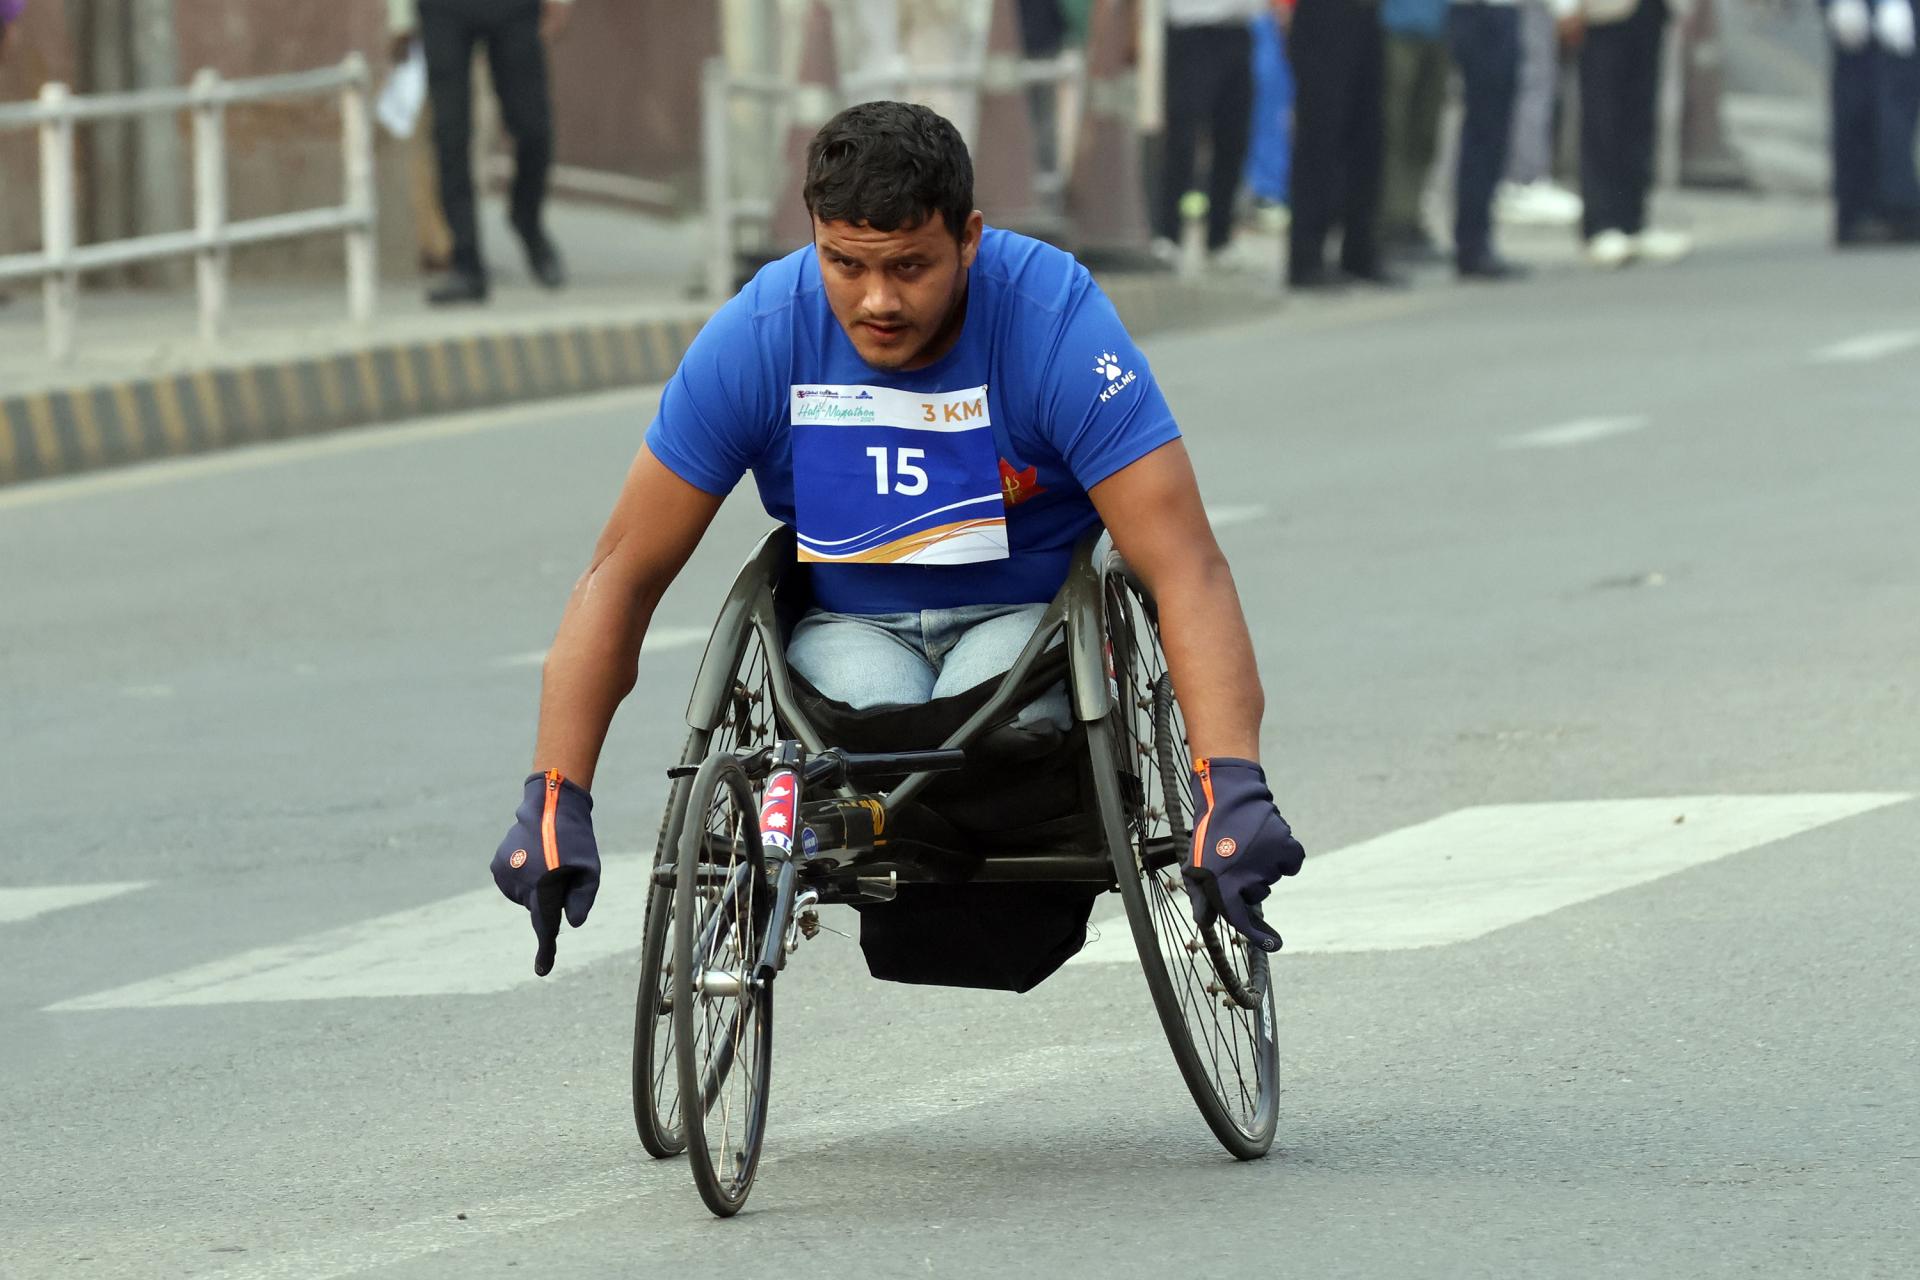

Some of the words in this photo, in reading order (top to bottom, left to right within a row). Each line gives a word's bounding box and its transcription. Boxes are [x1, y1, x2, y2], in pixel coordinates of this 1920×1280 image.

[1099, 370, 1136, 402] KELME
[922, 403, 936, 422] 3
[943, 398, 983, 422] KM
[866, 447, 928, 496] 15
